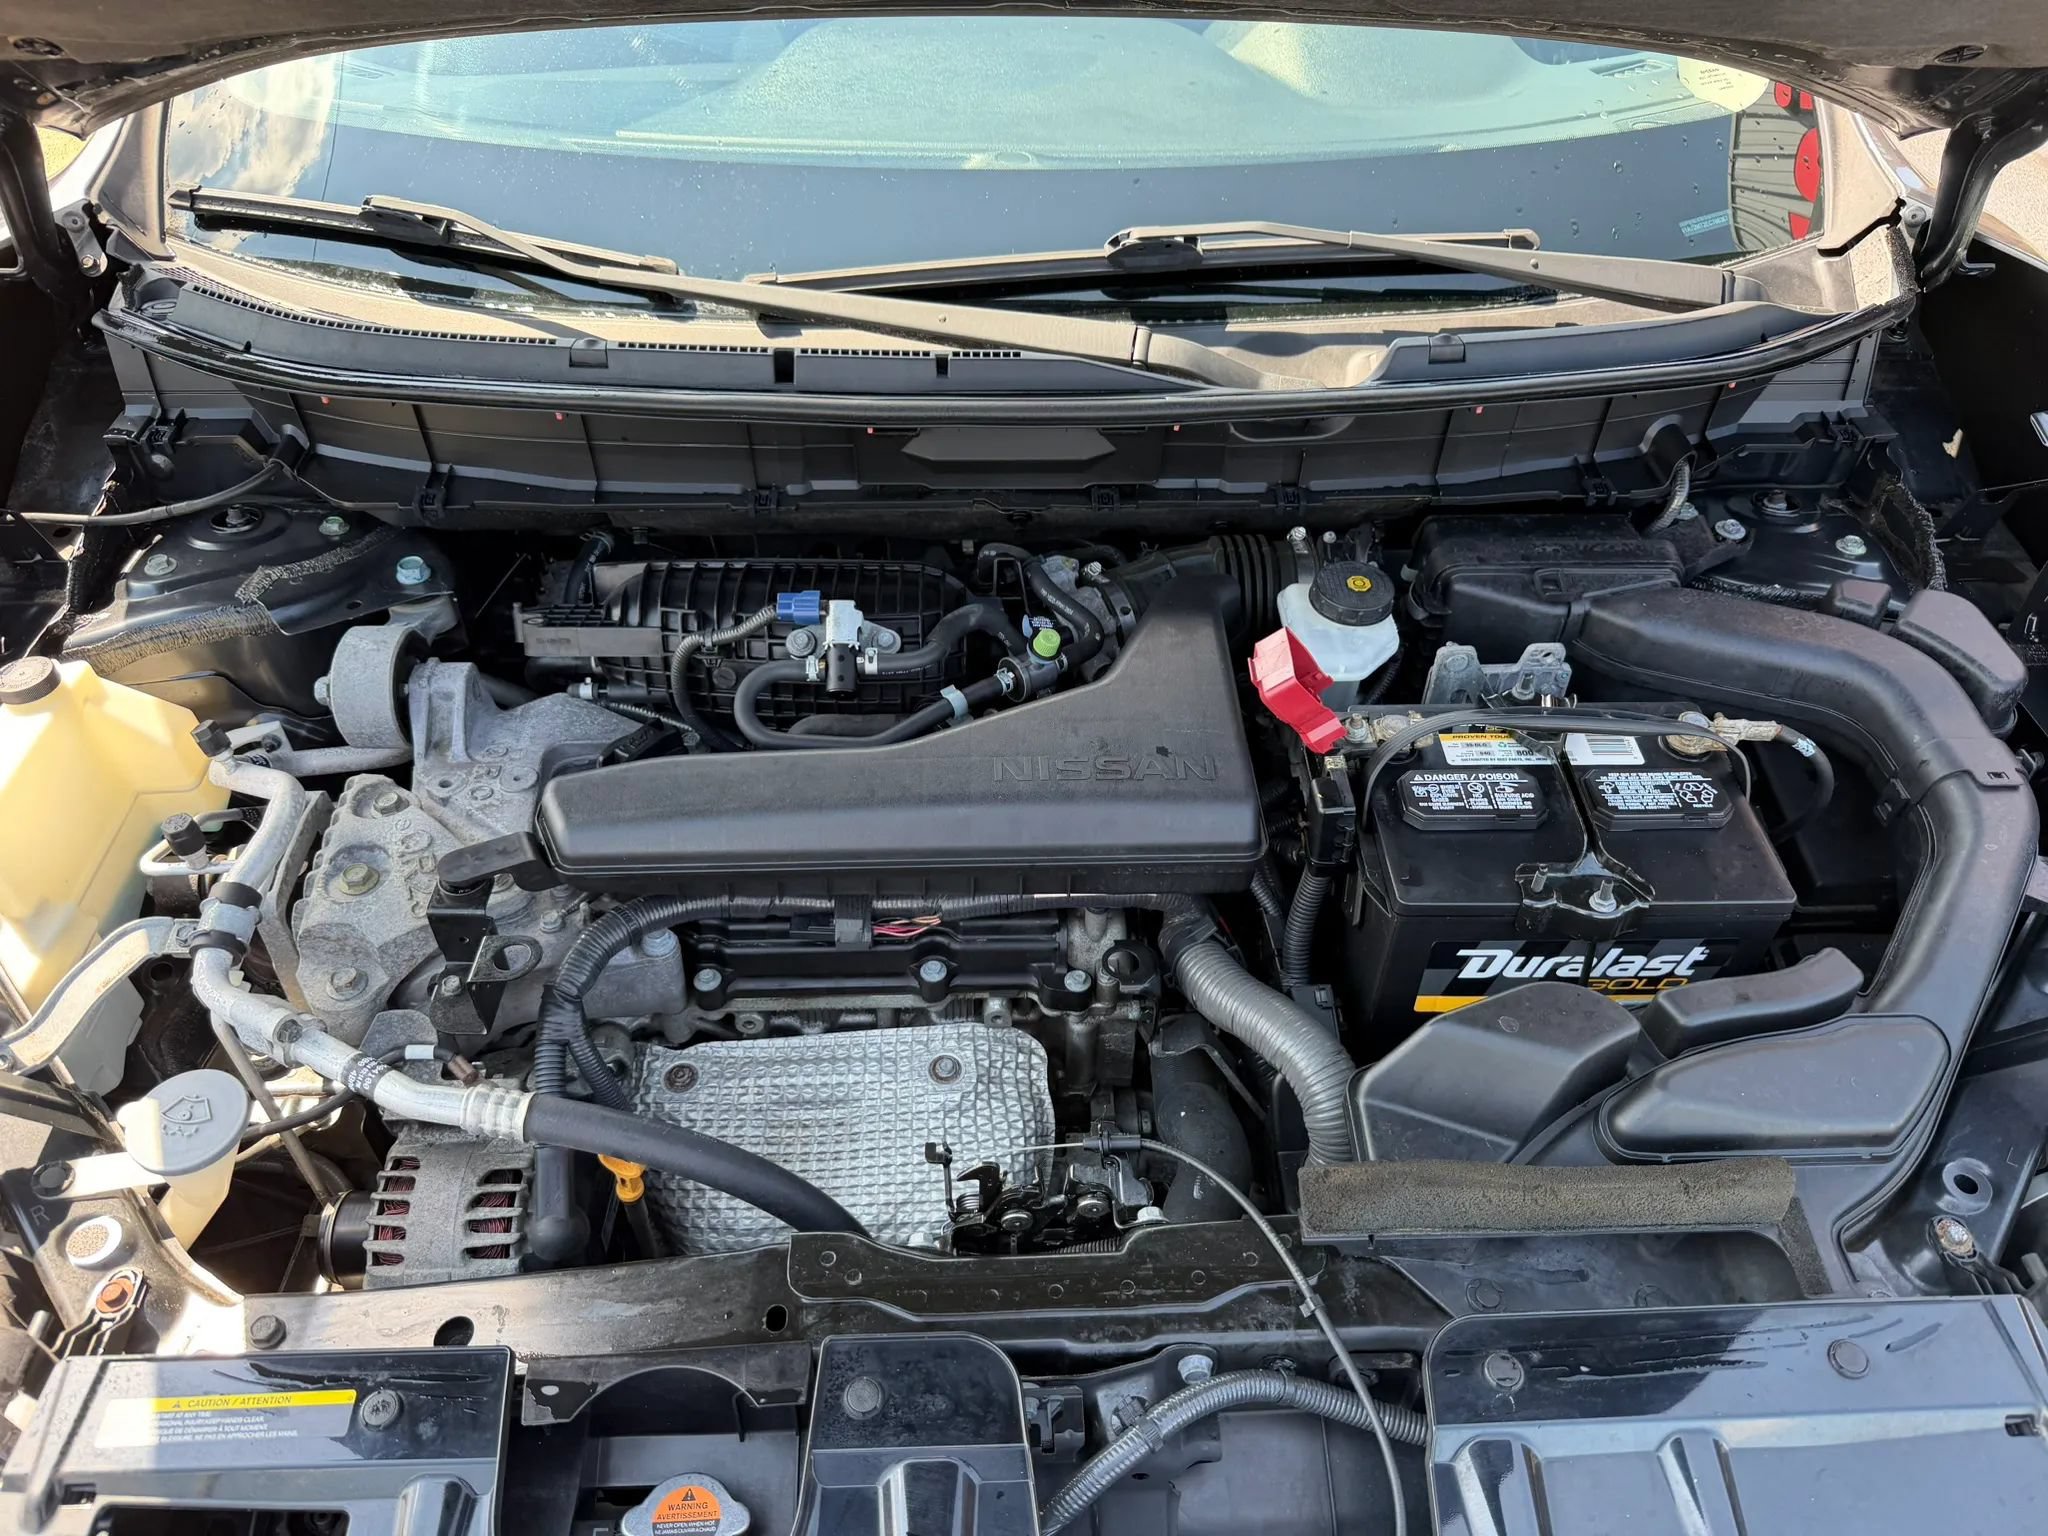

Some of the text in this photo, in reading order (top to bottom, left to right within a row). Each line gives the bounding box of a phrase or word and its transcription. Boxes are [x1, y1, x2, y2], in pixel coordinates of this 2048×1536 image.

[992, 755, 1217, 781] NISSAN
[1470, 773, 1476, 781] /
[1456, 947, 1707, 979] Duralast
[29, 1204, 51, 1226] R
[187, 1398, 230, 1408] CAUTION
[240, 1395, 291, 1406] ATTENTION
[668, 1502, 708, 1511] WARNING
[657, 1511, 717, 1520] AVERTISSEMENT
